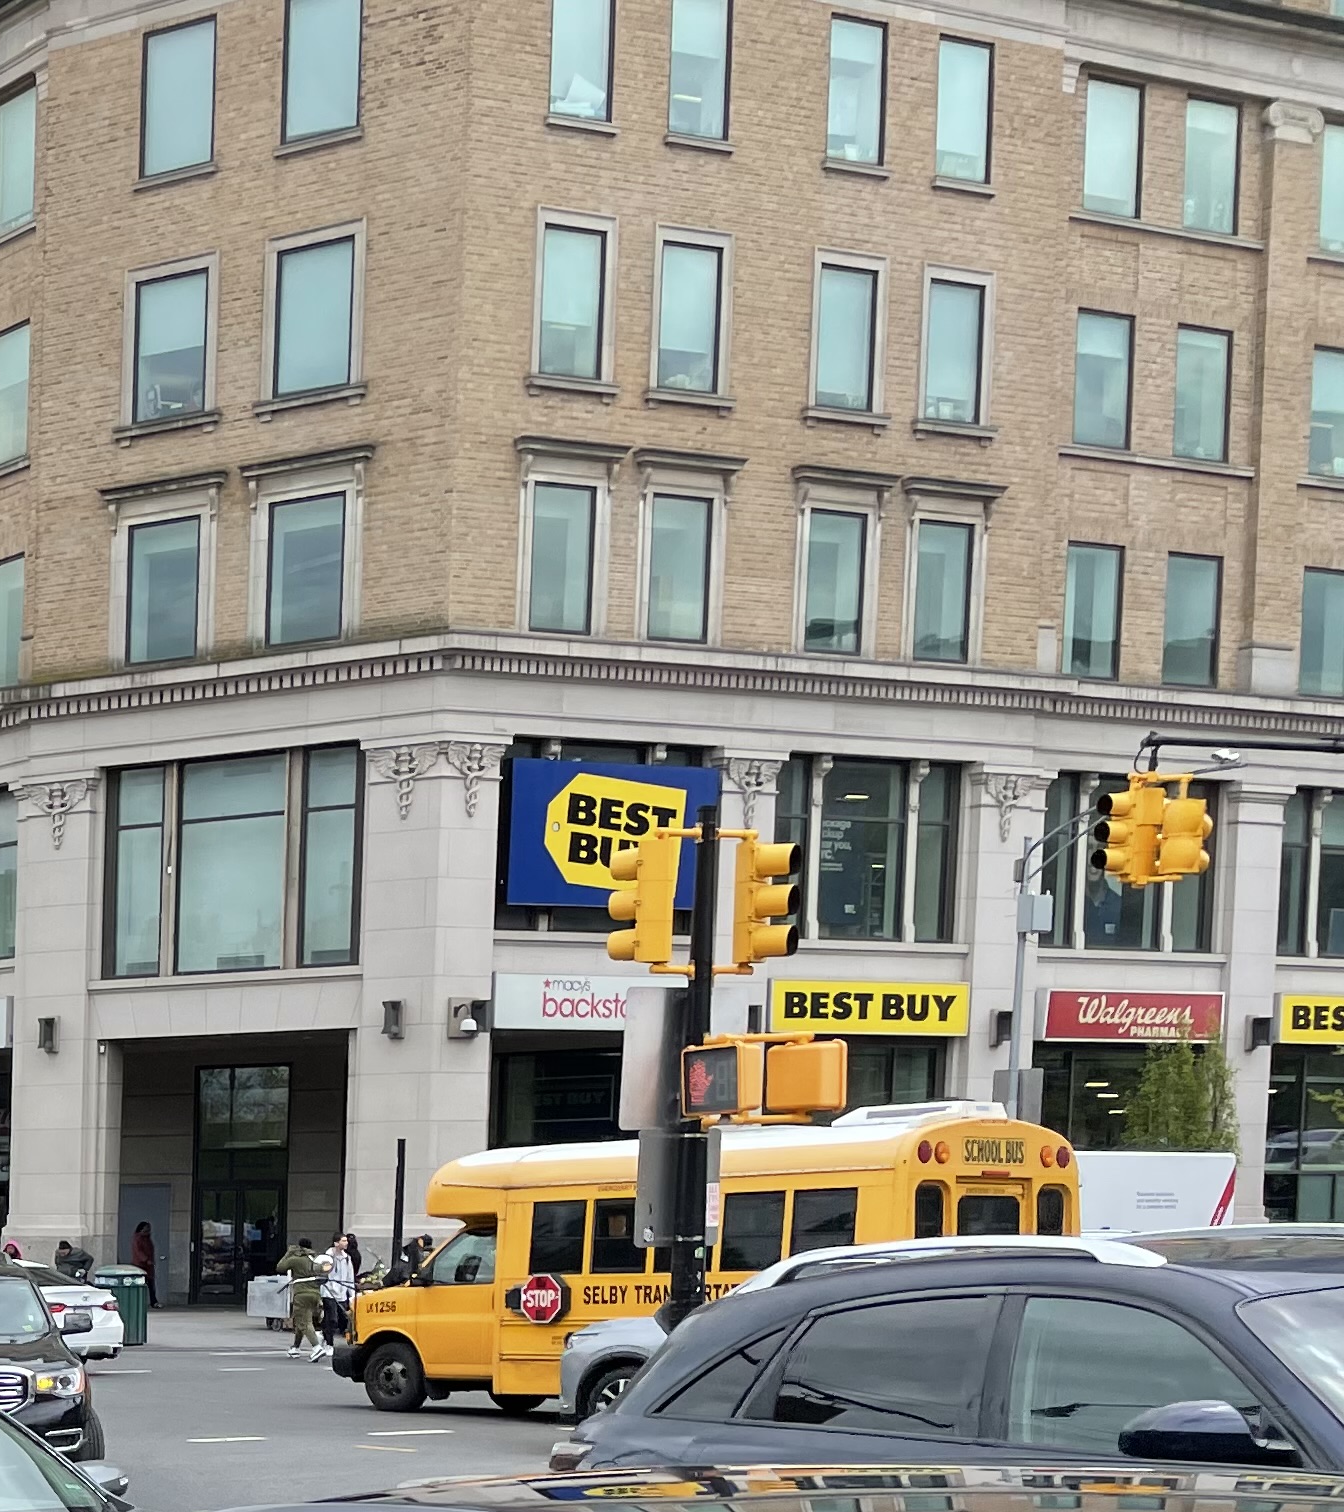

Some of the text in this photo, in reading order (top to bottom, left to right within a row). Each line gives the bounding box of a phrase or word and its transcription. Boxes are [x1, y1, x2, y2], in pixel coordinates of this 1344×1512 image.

[567, 792, 677, 836] BEST
[568, 832, 639, 869] BU
[542, 991, 627, 1019] backst
[784, 991, 958, 1022] BEST BUY
[1077, 994, 1195, 1035] Walgreens
[1292, 1005, 1344, 1032] BES
[965, 1139, 1025, 1163] SCHOOL BUS
[526, 1290, 554, 1308] STOP
[584, 1285, 628, 1305] SELBY
